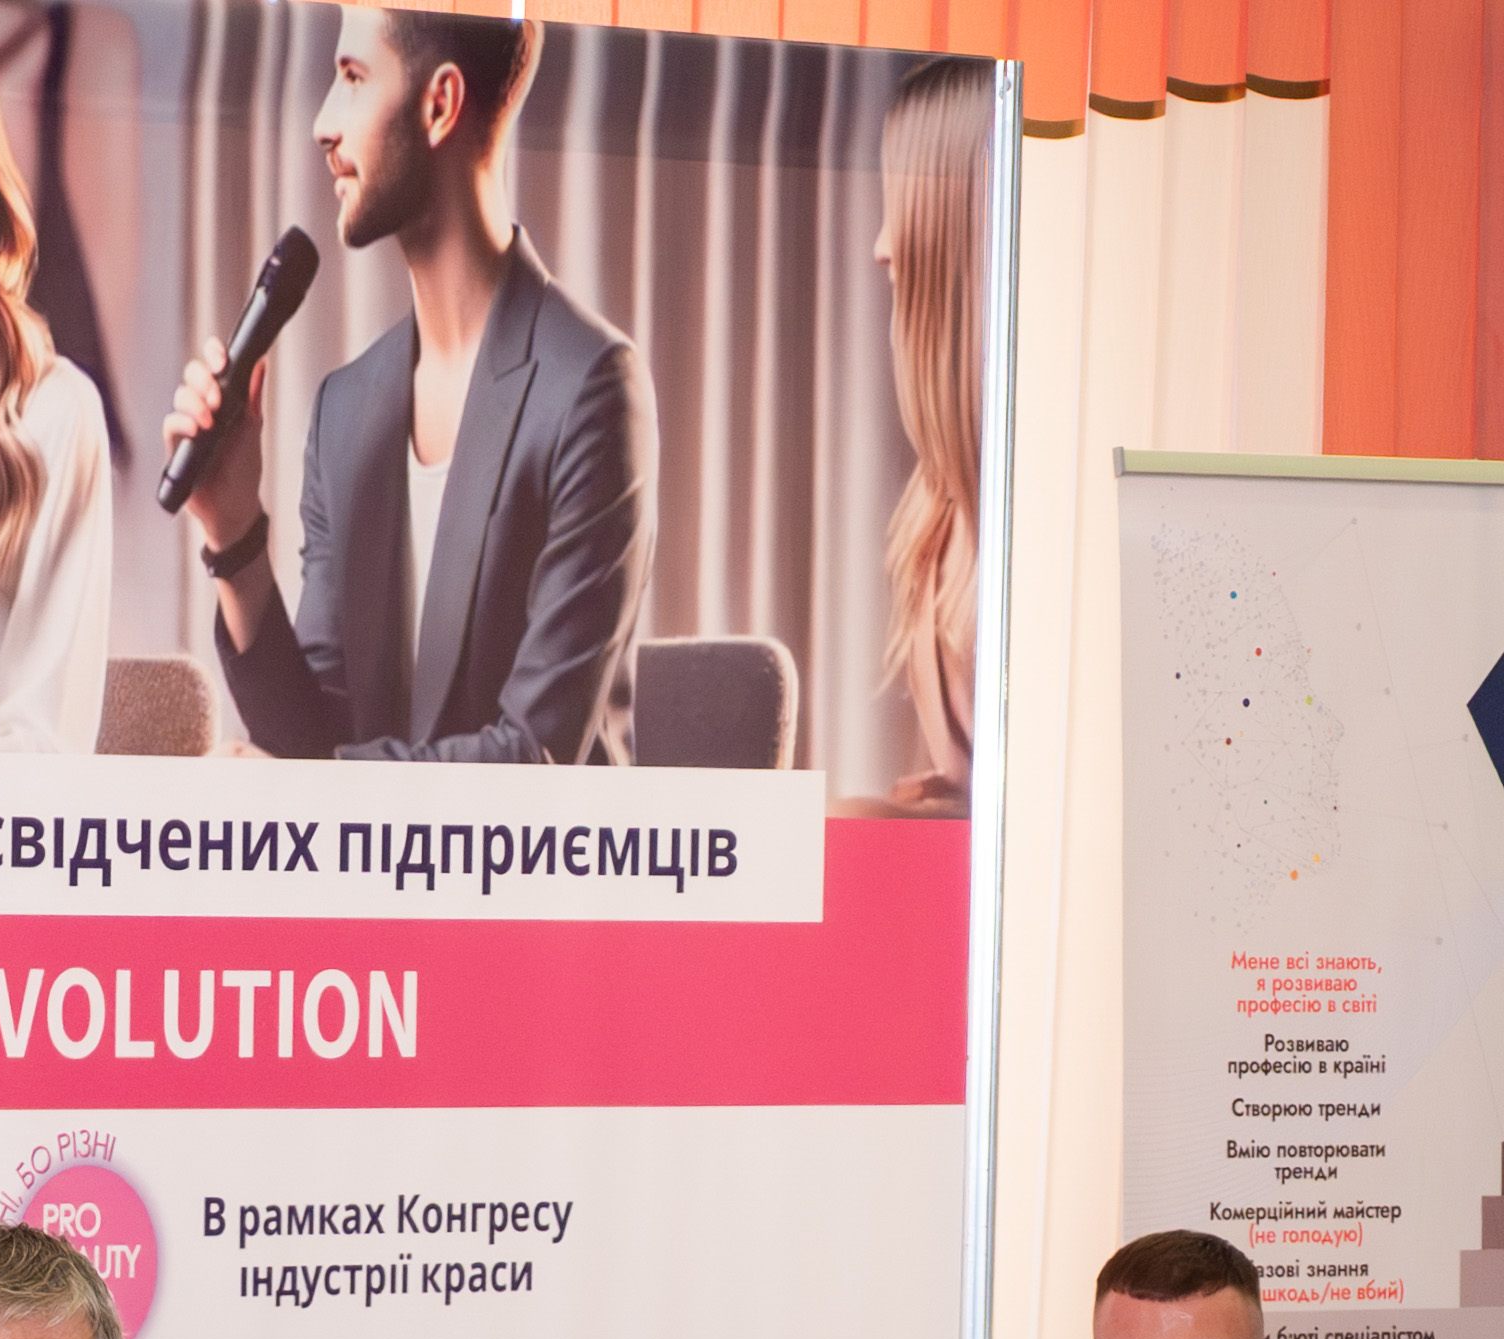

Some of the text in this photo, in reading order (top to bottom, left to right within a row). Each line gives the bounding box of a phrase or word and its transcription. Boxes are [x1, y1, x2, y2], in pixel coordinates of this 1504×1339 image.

[337, 823, 739, 895] підприємців
[1231, 950, 1382, 974] Мене всі знають,
[1256, 977, 1357, 997] я розвиваю
[1237, 994, 1377, 1018] професію в світі
[1264, 1033, 1349, 1052] Розвиваю
[1227, 1054, 1386, 1079] професію в країні
[1232, 1098, 1381, 1121] Створюю тренди
[16, 1129, 116, 1189] БО РІЗНІ
[1227, 1139, 1385, 1163] Вмію повторювати
[1275, 1166, 1338, 1184] тренди
[43, 1202, 101, 1238] PRO
[202, 1194, 573, 1249] В рамках Конгресу
[1209, 1201, 1402, 1225] Комерційний майстер
[1249, 1222, 1363, 1248] (не голодую)
[240, 1255, 534, 1307] індустрії краси
[1257, 1259, 1369, 1279] азові знання
[1262, 1278, 1405, 1304] шкодь/не вбий)
